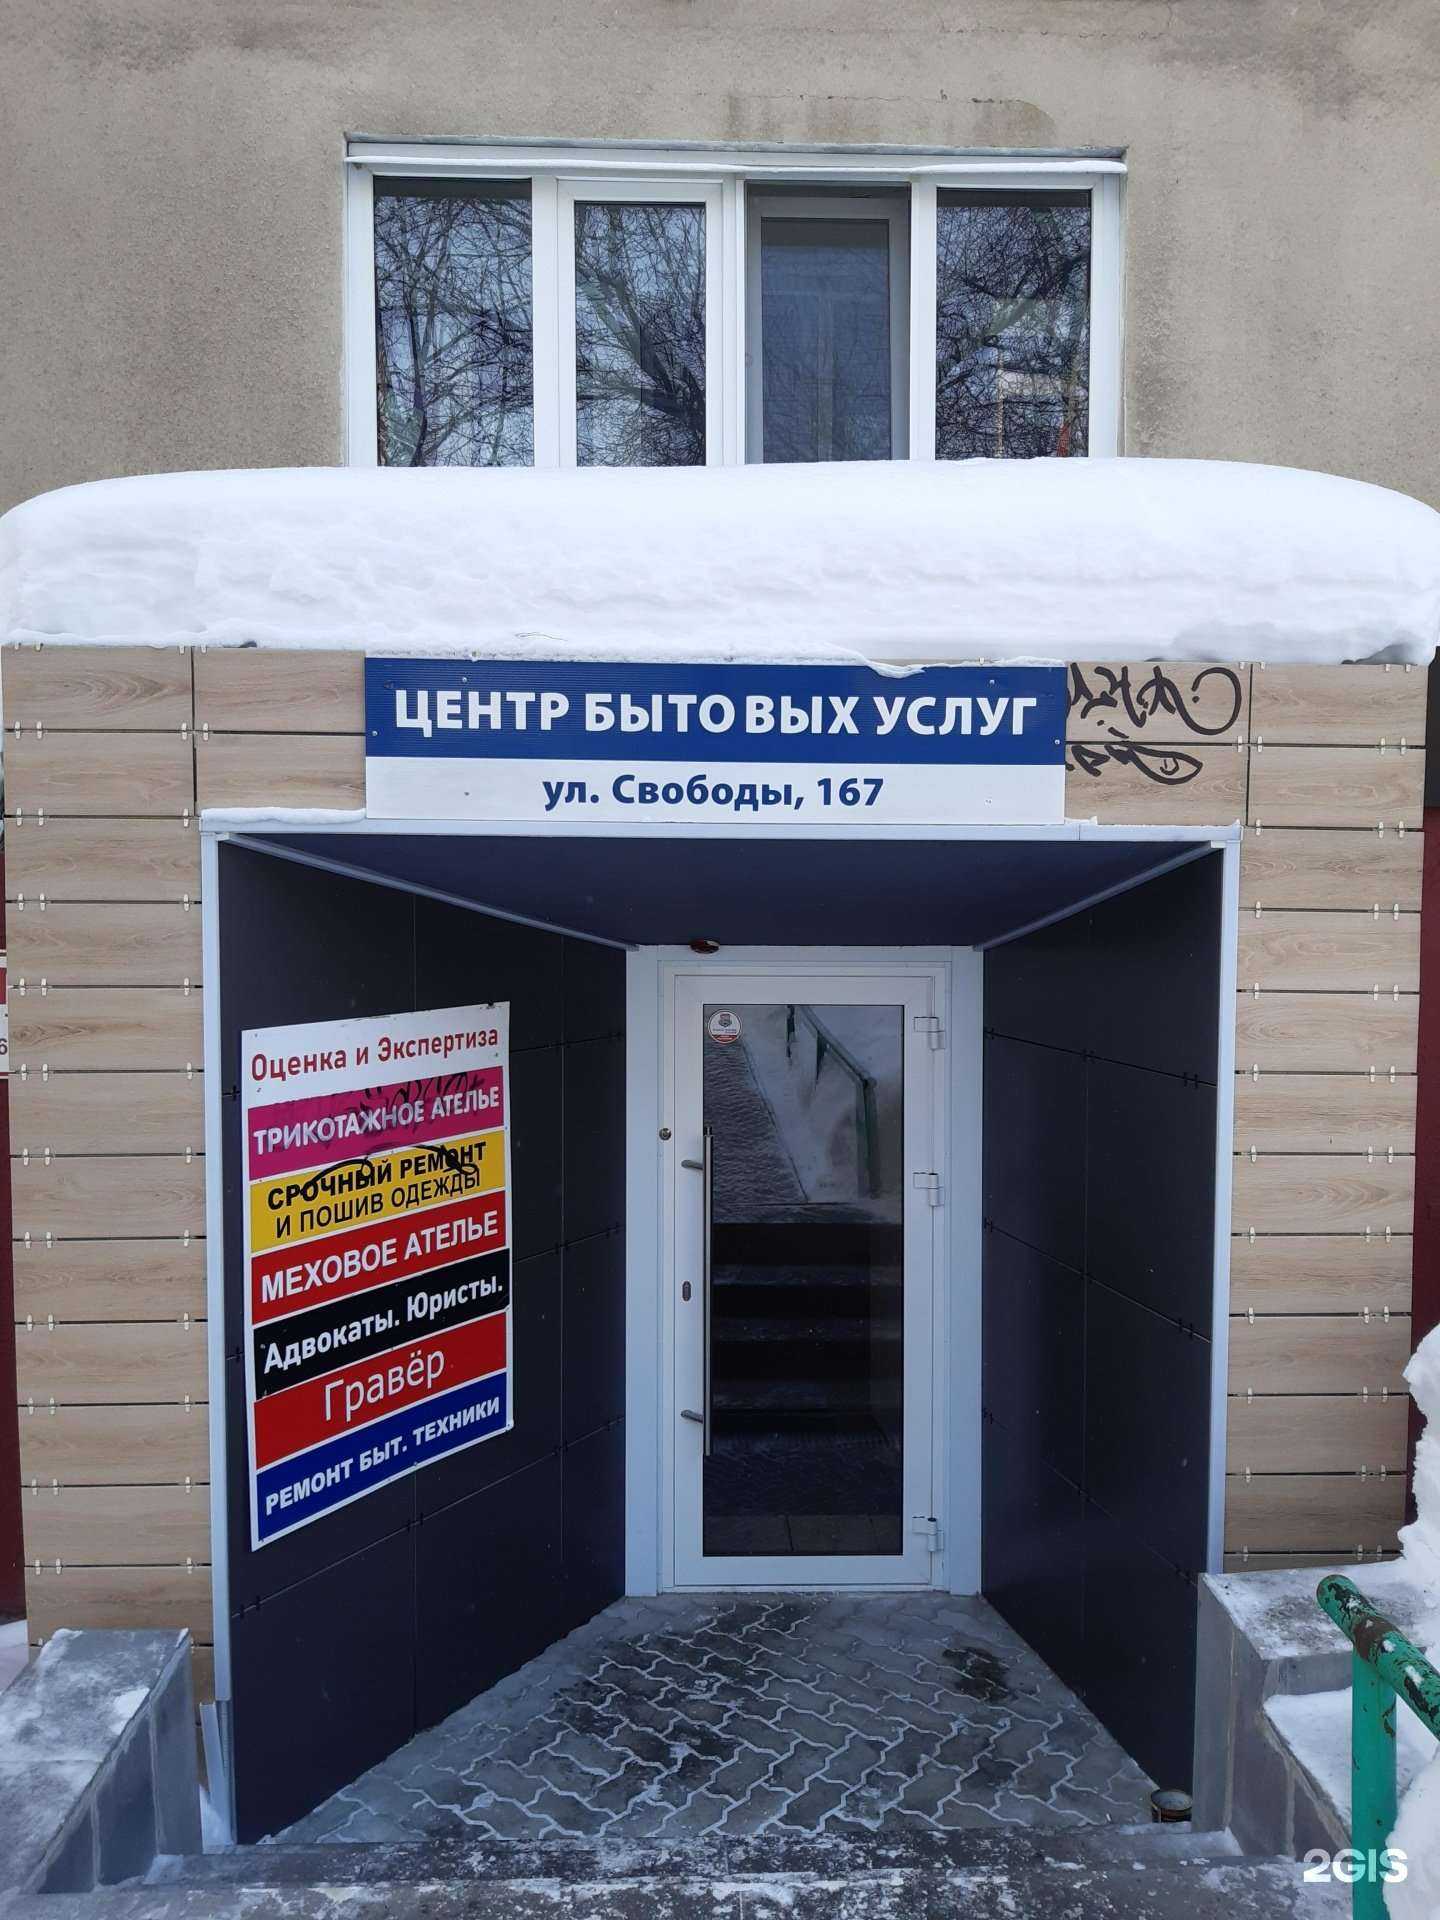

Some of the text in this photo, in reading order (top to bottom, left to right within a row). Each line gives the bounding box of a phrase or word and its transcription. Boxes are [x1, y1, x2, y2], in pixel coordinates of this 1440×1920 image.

[396, 690, 569, 737] ЦЕНТР
[873, 696, 1037, 736] УСЛУГ
[542, 774, 884, 812] ул. Свободы, 167
[251, 1028, 498, 1081] Оценка и Экспертиза
[254, 1100, 425, 1155] ТРИКОТАЖНОЕ
[431, 1086, 499, 1117] АТЕЛЬЕ
[267, 1141, 486, 1210] СРОЧНЫЙ РЕМОНТ
[276, 1171, 480, 1238] И ПОШИВ ОДЕЖДЫ
[261, 1209, 498, 1303] МЕХОВОЕ АТЕЛЬЕ
[264, 1275, 503, 1374] Адвокаты. Юристы.
[323, 1349, 445, 1422] Гравёр
[265, 1396, 500, 1516] РЕМОНТ БЫТ. ТЕХНИКИ
